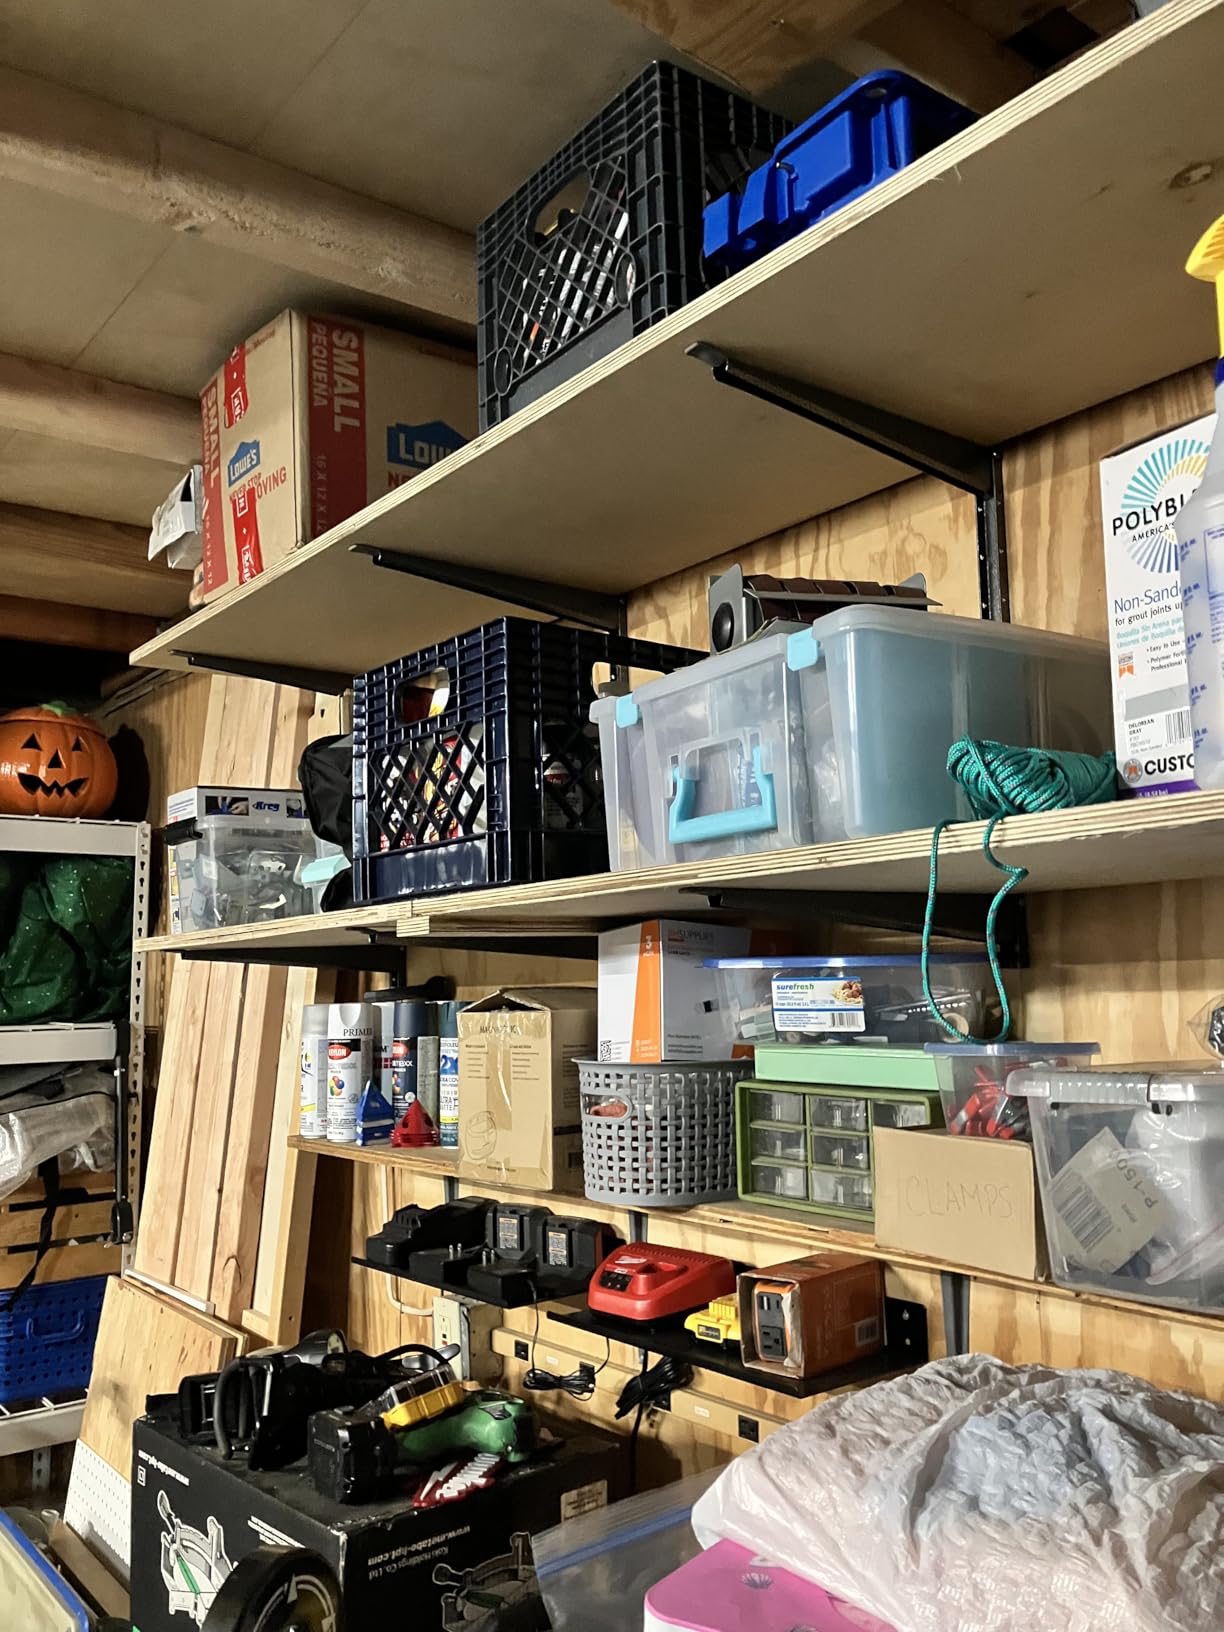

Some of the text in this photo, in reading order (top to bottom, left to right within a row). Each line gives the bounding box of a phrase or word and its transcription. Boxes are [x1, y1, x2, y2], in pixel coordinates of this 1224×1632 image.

[332, 329, 361, 432] SMALL
[207, 385, 221, 488] SMALL
[229, 447, 259, 482] LOWE'S
[256, 466, 288, 499] OVING
[1113, 580, 1182, 615] Non-Sand
[1115, 617, 1126, 627] for
[1127, 611, 1149, 624] grout
[1150, 604, 1172, 619] joints
[255, 800, 280, 813] Kreg
[904, 1175, 1013, 1219] CLAMPS
